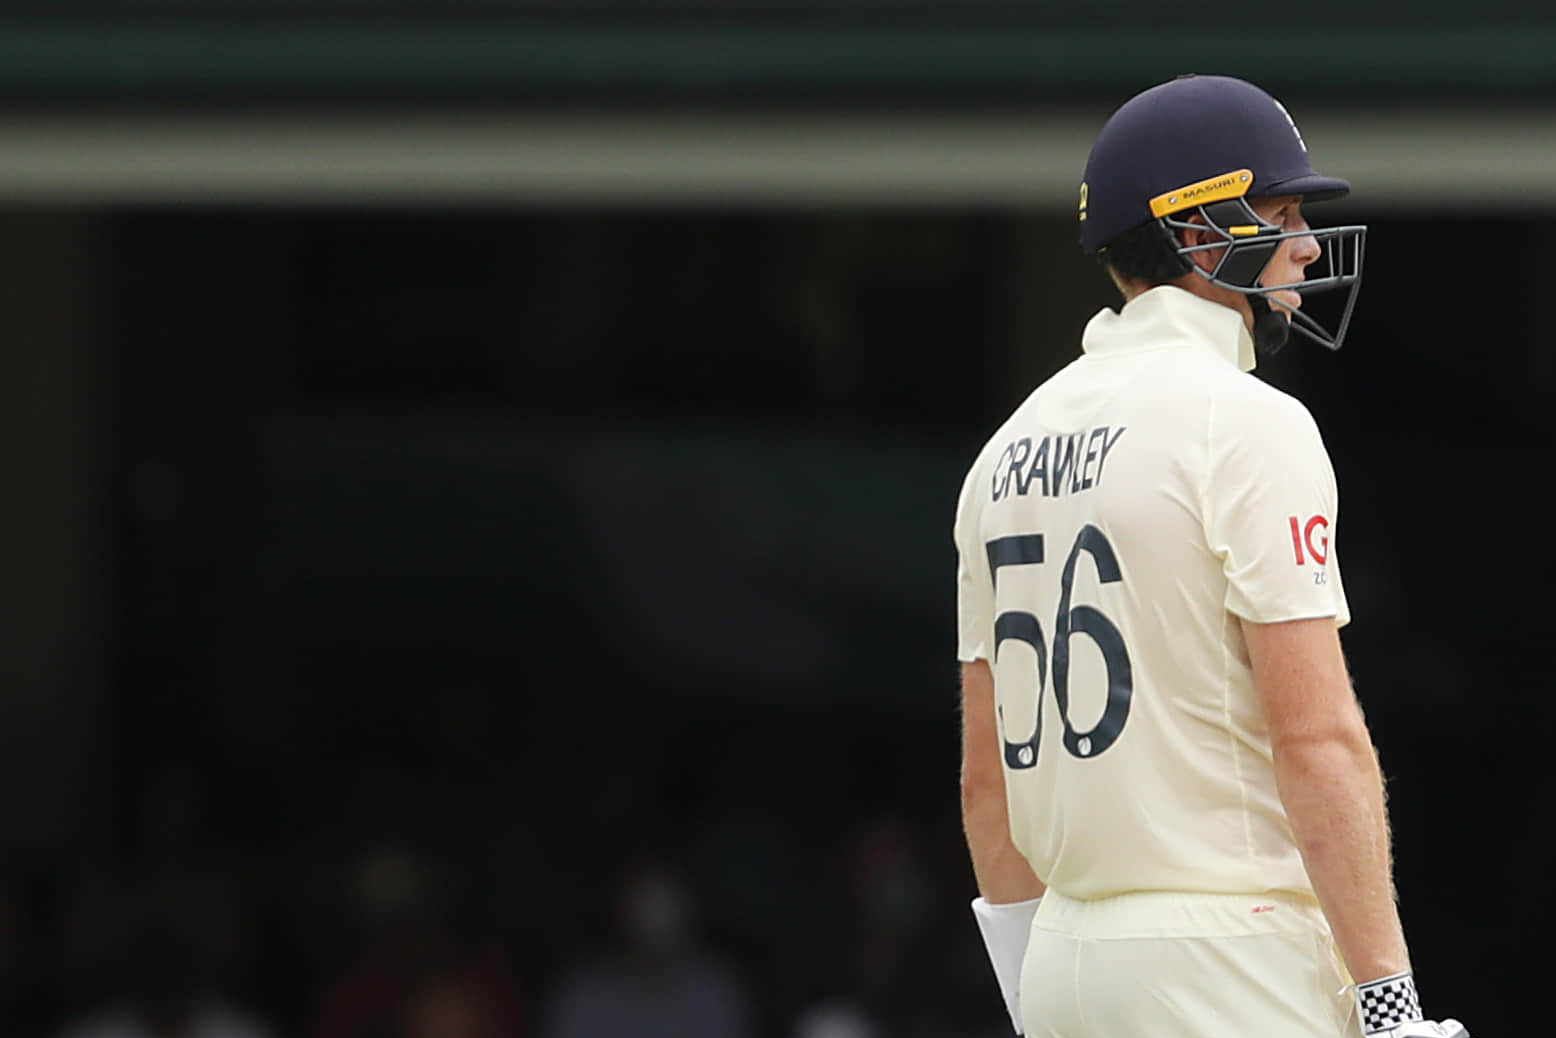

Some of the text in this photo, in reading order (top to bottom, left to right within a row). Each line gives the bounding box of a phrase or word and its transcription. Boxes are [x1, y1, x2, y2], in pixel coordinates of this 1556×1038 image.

[1183, 178, 1235, 199] MASURI
[992, 426, 1128, 502] CRAWLEY
[1289, 514, 1329, 566] IG
[985, 523, 1133, 769] 56
